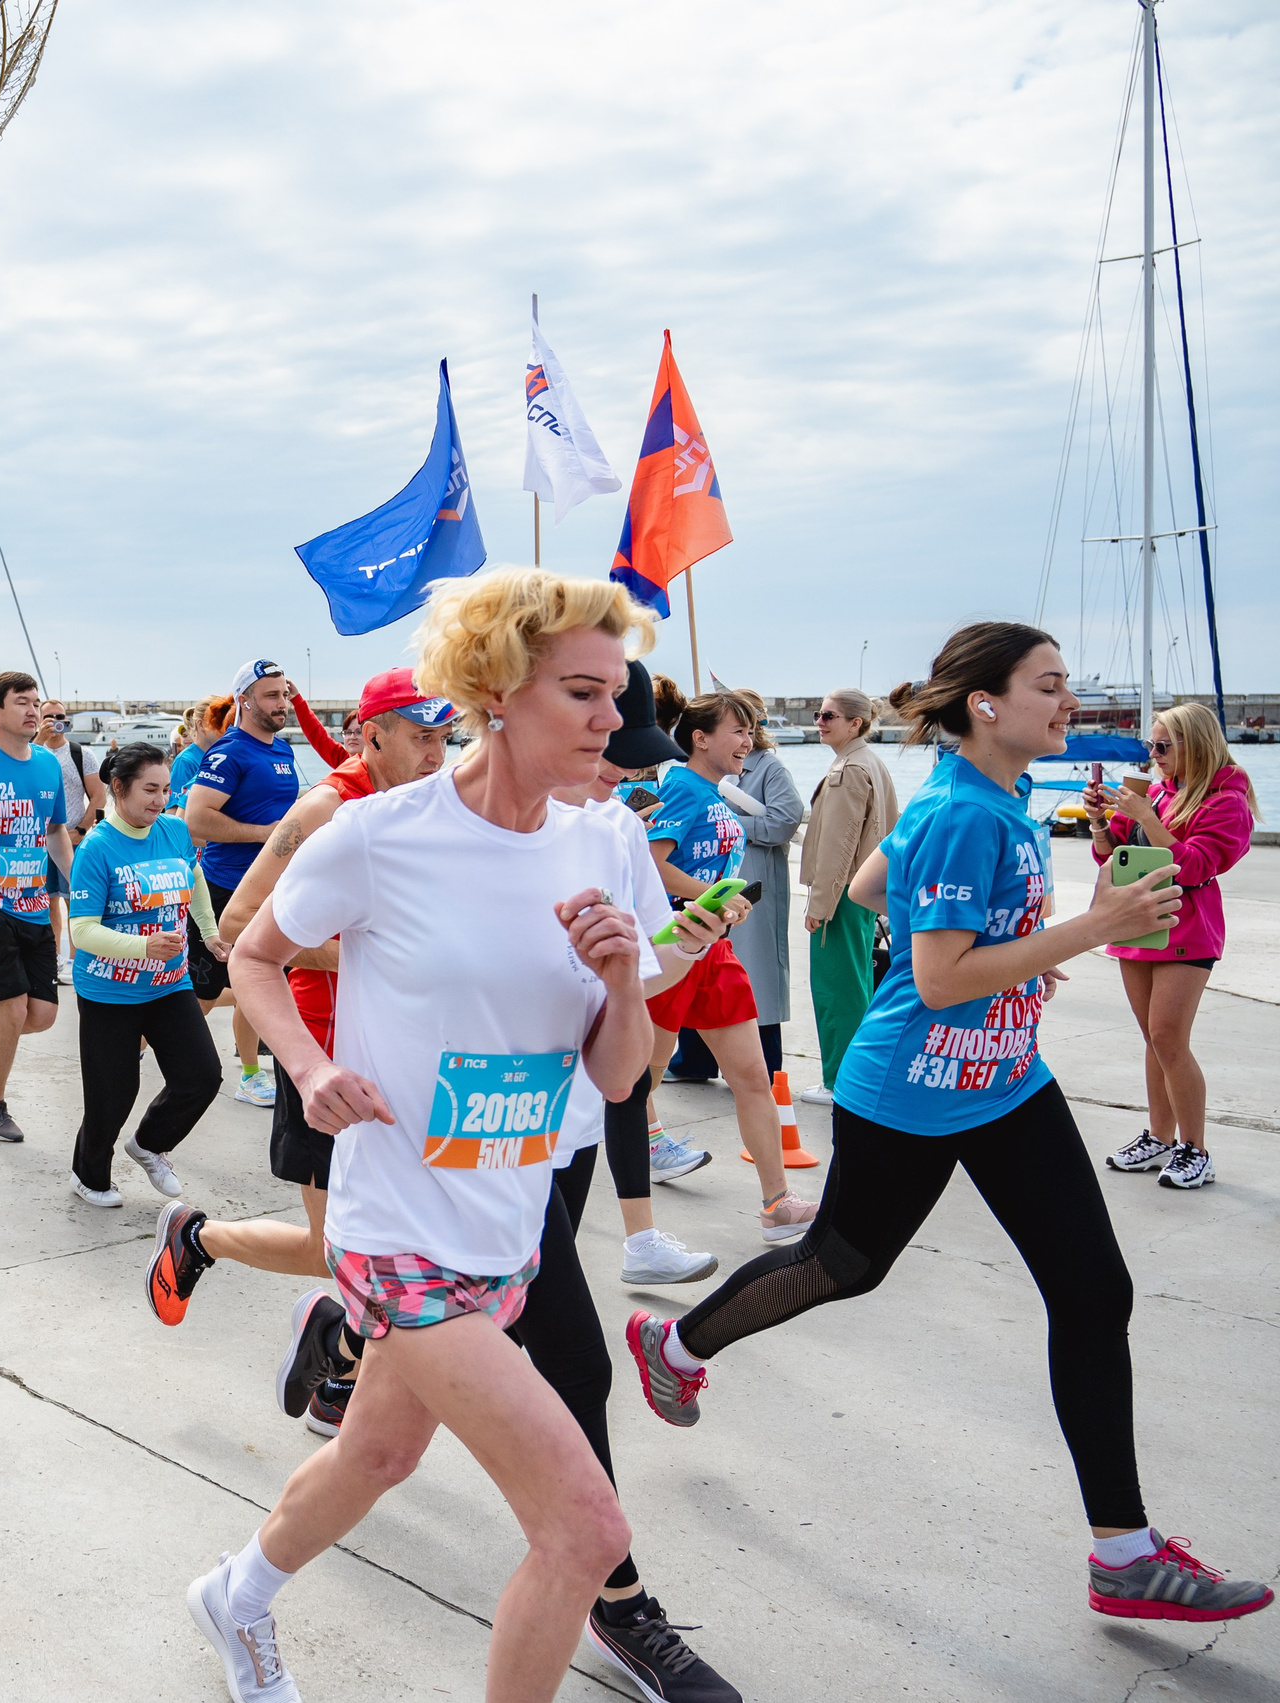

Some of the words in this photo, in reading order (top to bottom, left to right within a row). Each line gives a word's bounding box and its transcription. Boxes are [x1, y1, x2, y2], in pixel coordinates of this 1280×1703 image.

[198, 771, 225, 784] 2023
[9, 860, 41, 875] 20027
[149, 872, 186, 891] 20073
[86, 960, 140, 984] #ЗАБЕГ
[923, 1022, 1035, 1061] #ЛЮБОВЬ
[464, 1058, 488, 1069] ПСБ
[906, 1053, 999, 1090] #ЗАБЕГ
[461, 1091, 548, 1133] 20183
